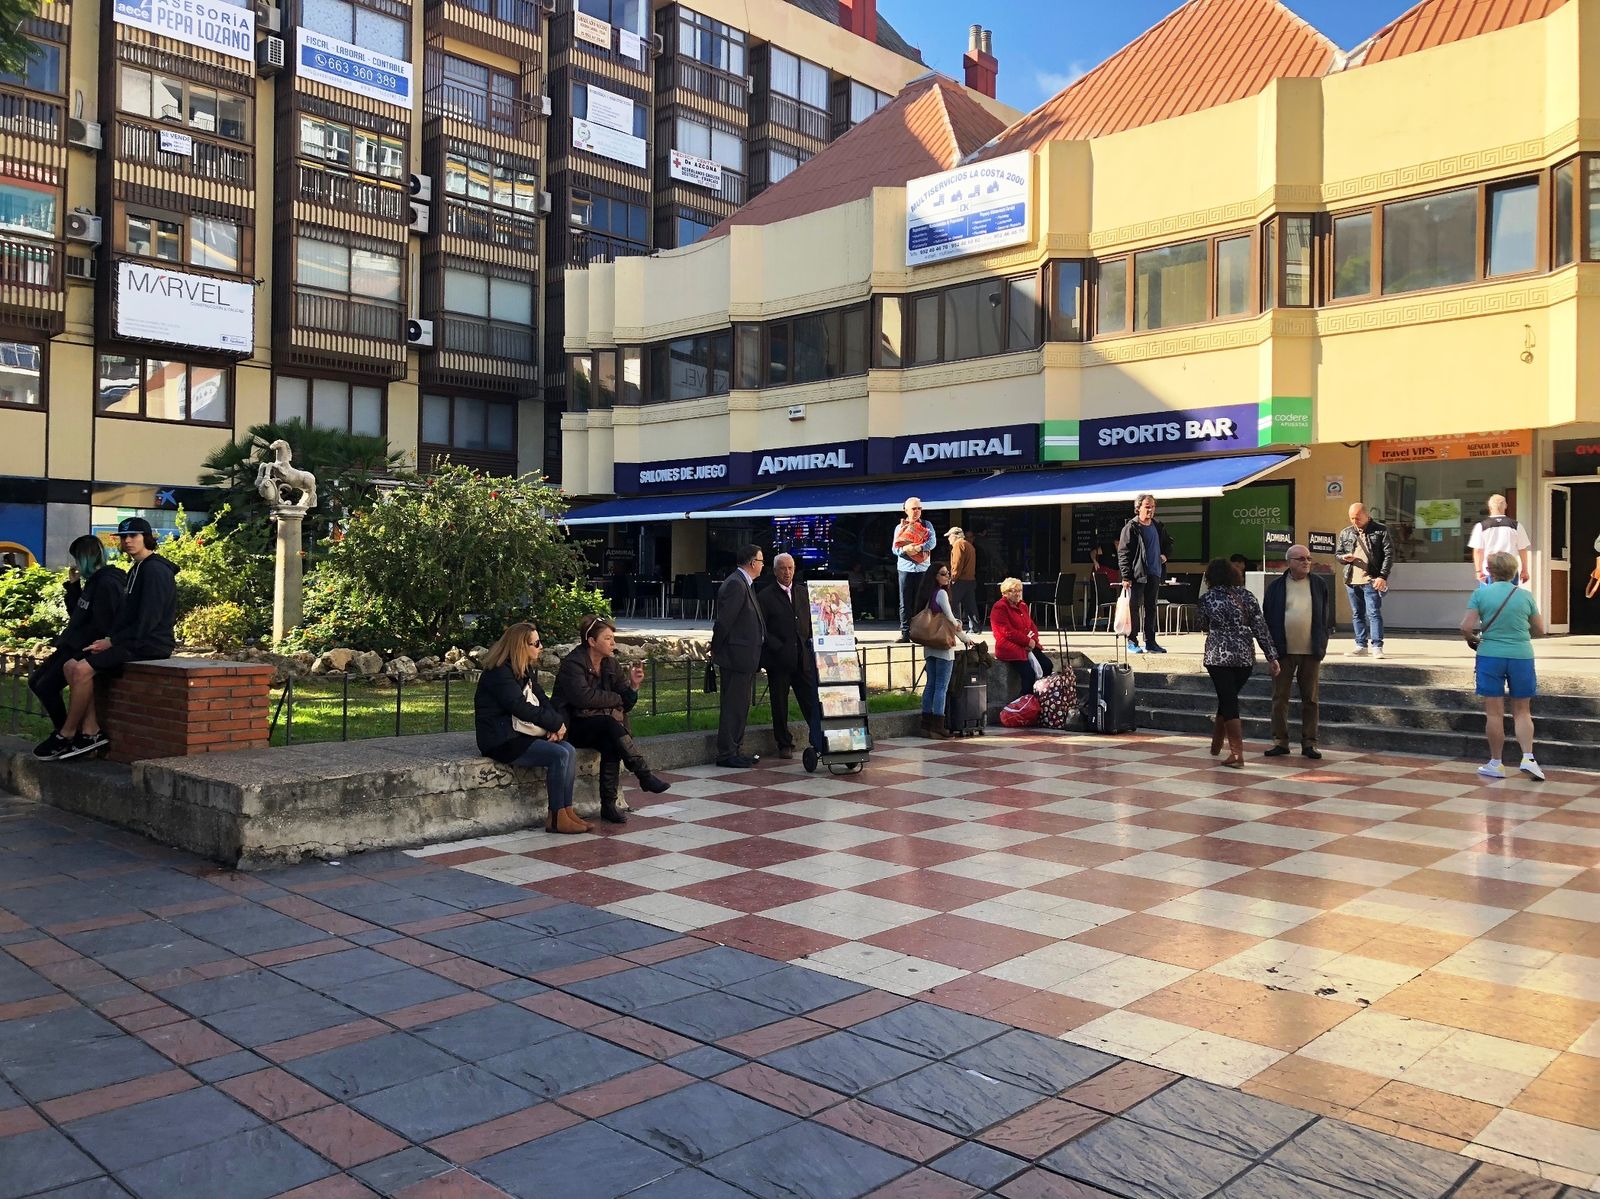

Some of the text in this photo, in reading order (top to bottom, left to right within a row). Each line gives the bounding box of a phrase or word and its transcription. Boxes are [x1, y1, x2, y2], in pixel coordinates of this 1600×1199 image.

[117, 3, 150, 19] aece
[157, 6, 251, 52] PEPA LOZANO
[306, 35, 330, 51] FISCAL
[336, 45, 366, 62] LABORAL
[372, 57, 405, 74] CONTABLE
[328, 57, 350, 74] 663
[352, 65, 374, 81] 360
[376, 72, 396, 89] 389
[694, 162, 717, 172] AZCONA
[910, 168, 1025, 213] MULTISERVICIOS LA COSTA 2000
[1274, 413, 1309, 422] codere
[1098, 417, 1235, 447] SPORTS BAR
[902, 433, 1022, 465] ADMIRAL
[1381, 446, 1435, 458] travel VIPS
[1469, 449, 1490, 457] TRAVEL
[757, 448, 854, 475] ADMIRAL
[639, 464, 728, 484] SALONES DE JUEGO
[1232, 506, 1281, 519] codere
[1239, 517, 1281, 526] APUESTAS
[1265, 532, 1293, 544] ADMIRAL
[1309, 534, 1335, 546] ADMIRAL
